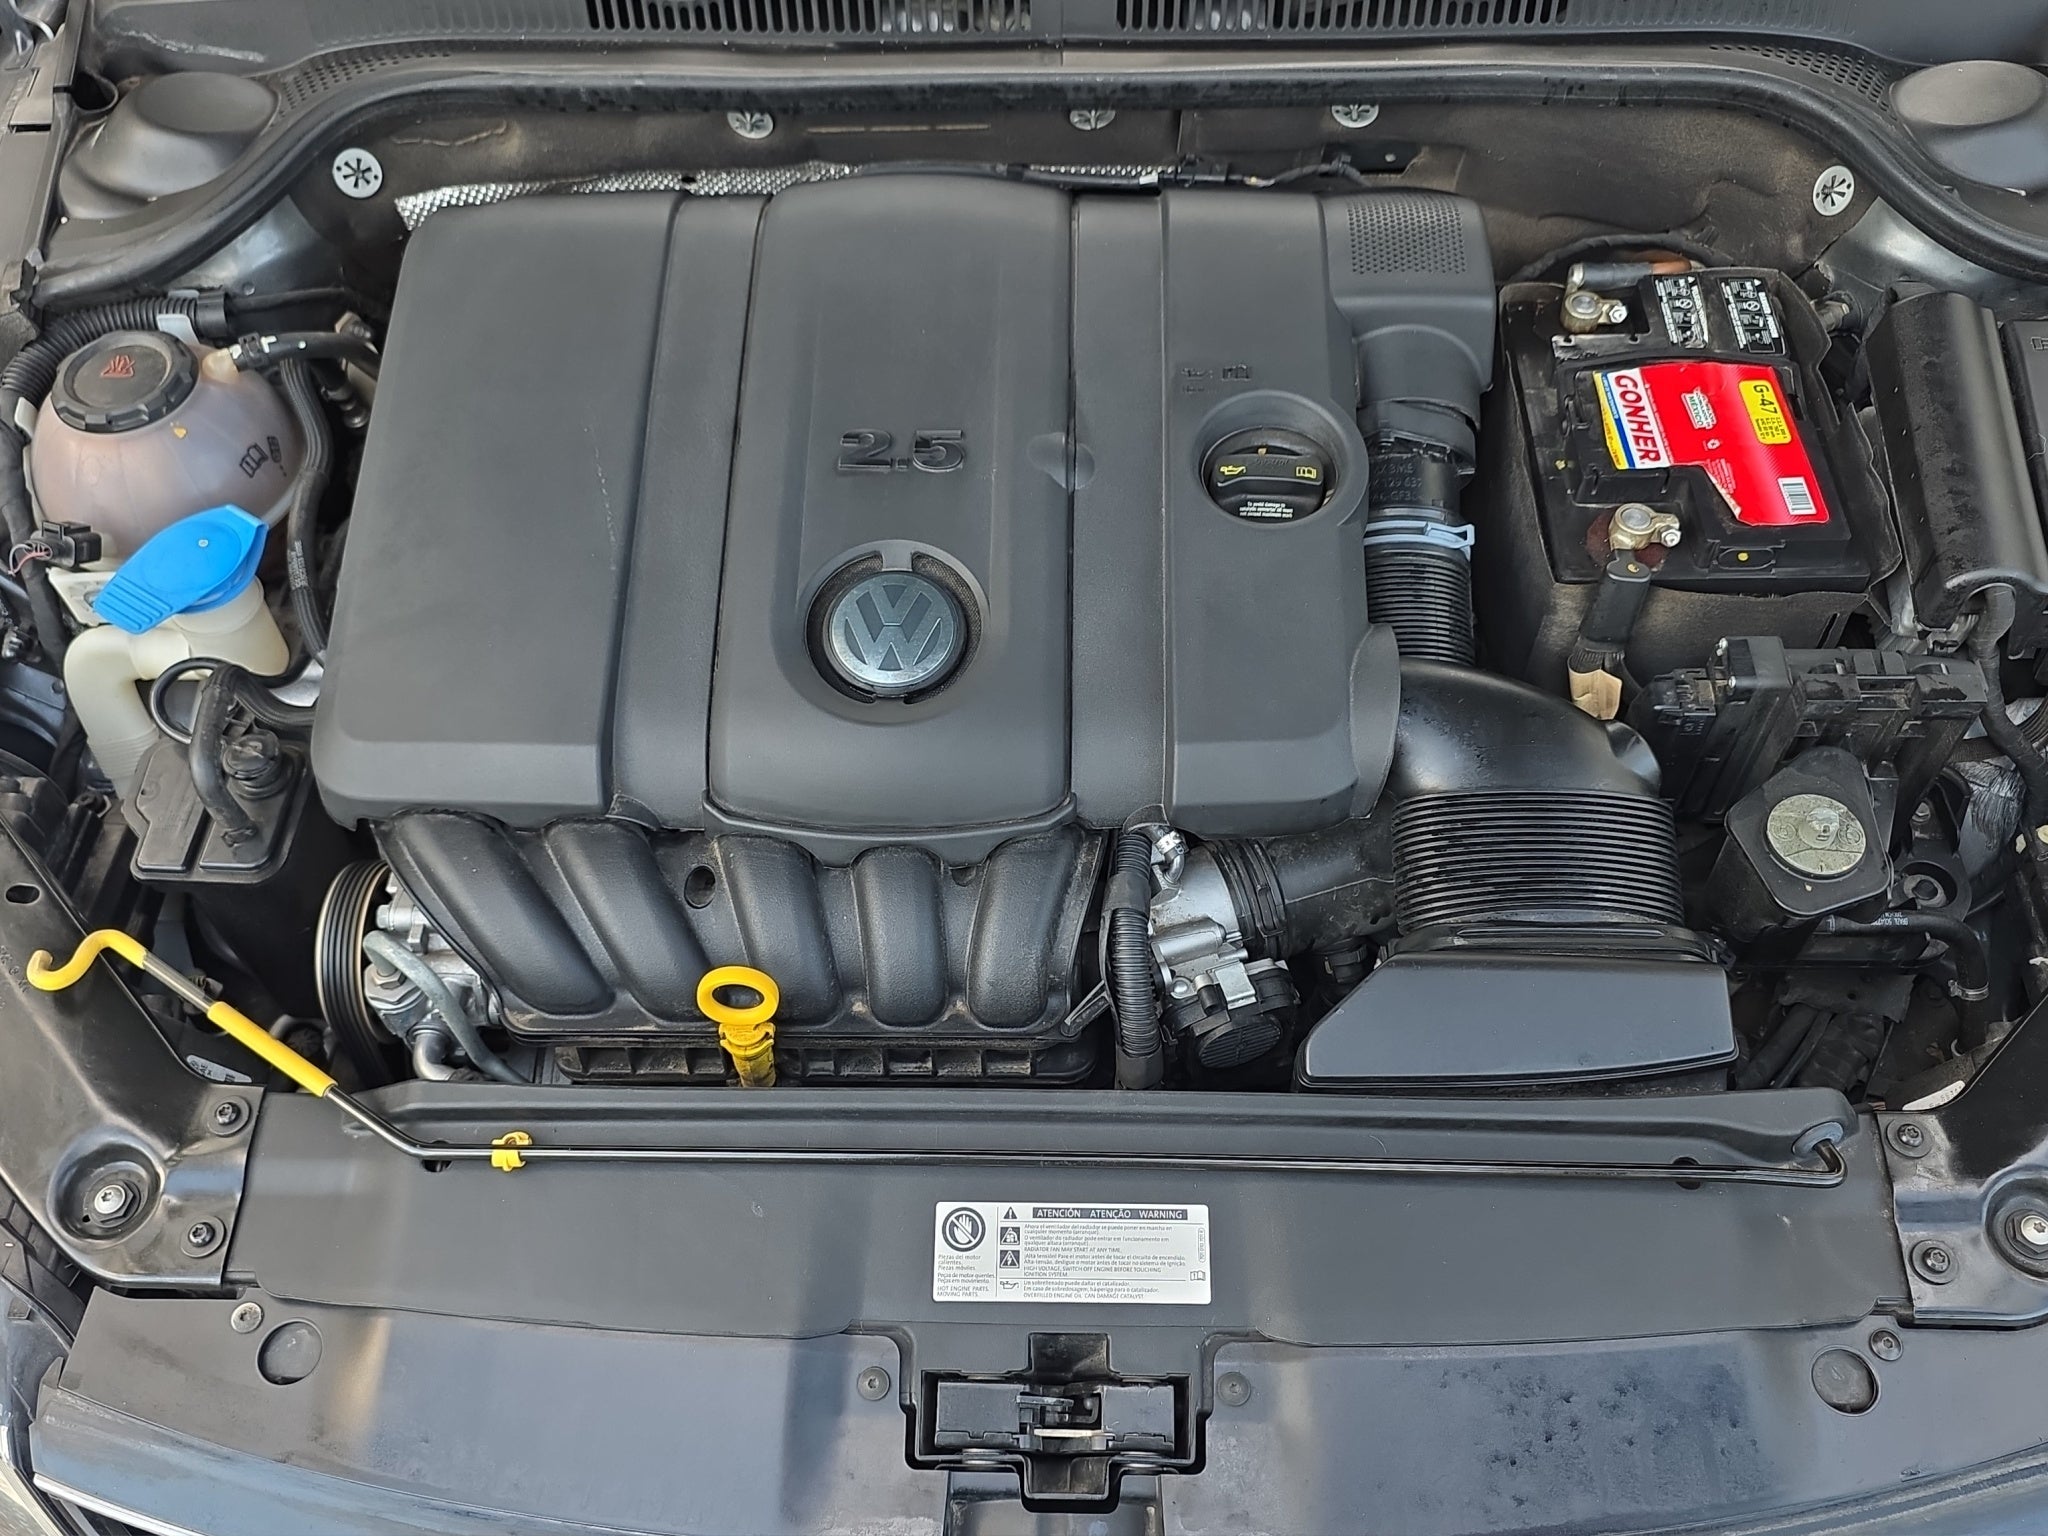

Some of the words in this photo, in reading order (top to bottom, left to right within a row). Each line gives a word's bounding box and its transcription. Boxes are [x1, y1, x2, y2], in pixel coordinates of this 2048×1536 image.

[1688, 396, 1704, 426] MÉXICO
[1753, 384, 1778, 414] G-47
[1614, 374, 1661, 462] GONHER
[838, 428, 965, 472] 2.5
[1037, 1208, 1081, 1217] ATENCIÓN
[1090, 1208, 1131, 1219] ATENÇÃO
[1139, 1210, 1182, 1219] WARNING
